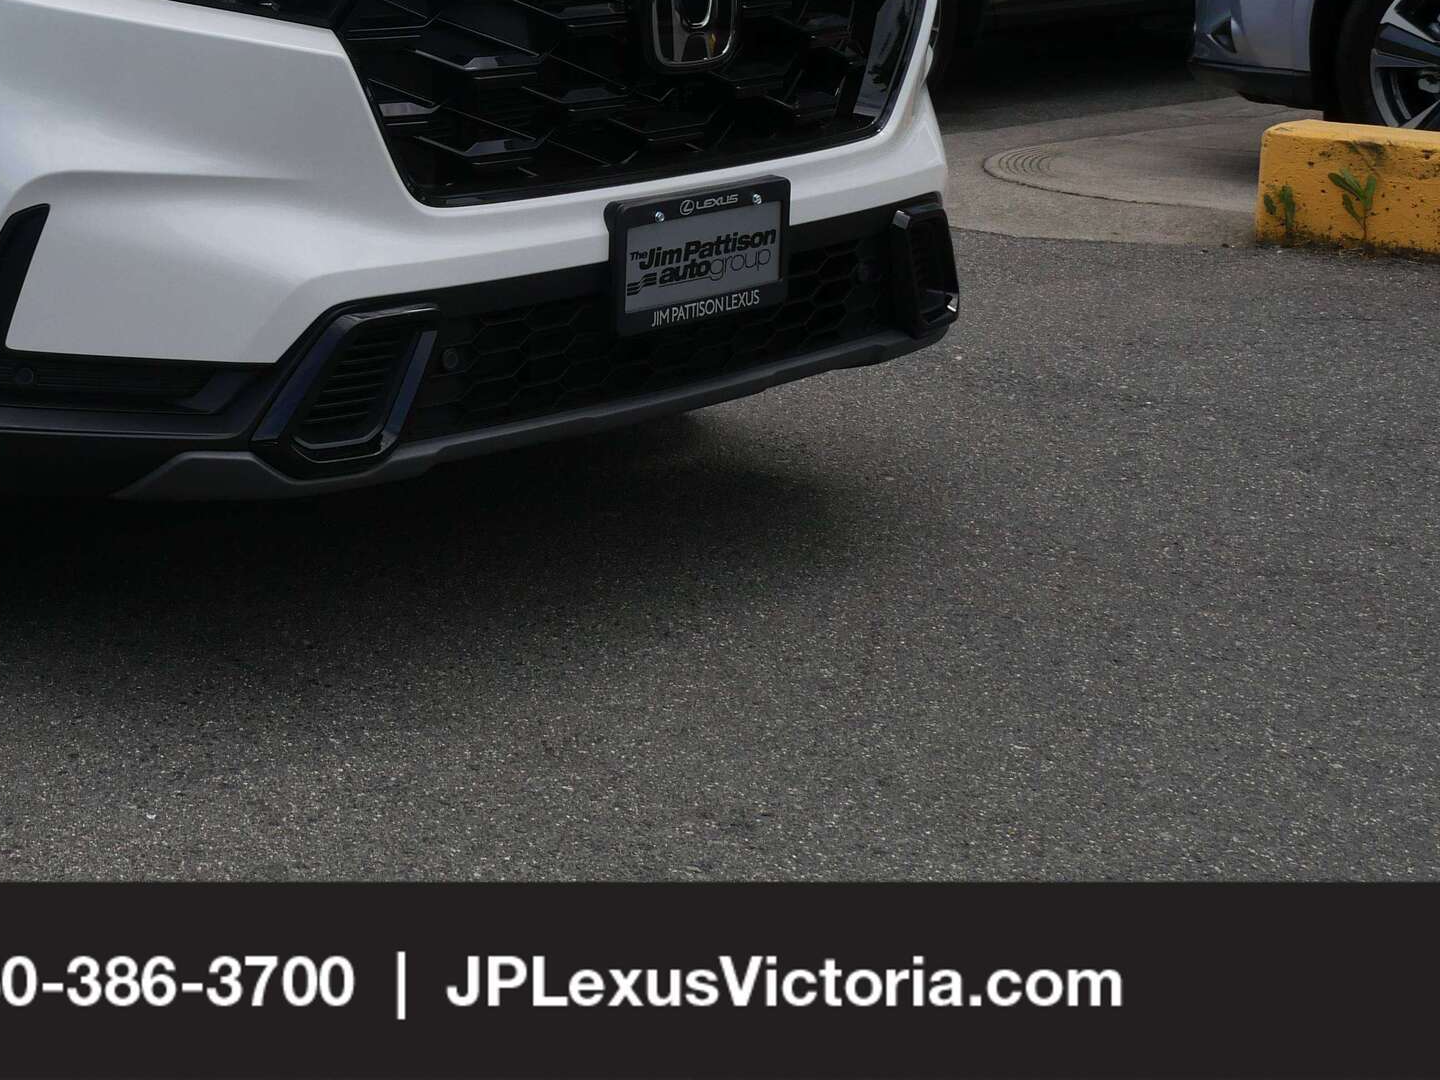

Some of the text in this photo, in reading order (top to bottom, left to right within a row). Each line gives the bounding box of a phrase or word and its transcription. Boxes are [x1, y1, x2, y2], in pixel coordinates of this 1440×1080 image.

[696, 194, 739, 210] LEXUS
[630, 228, 777, 270] The Jim Pattison
[651, 289, 761, 328] JIM PATTISON LEXUS
